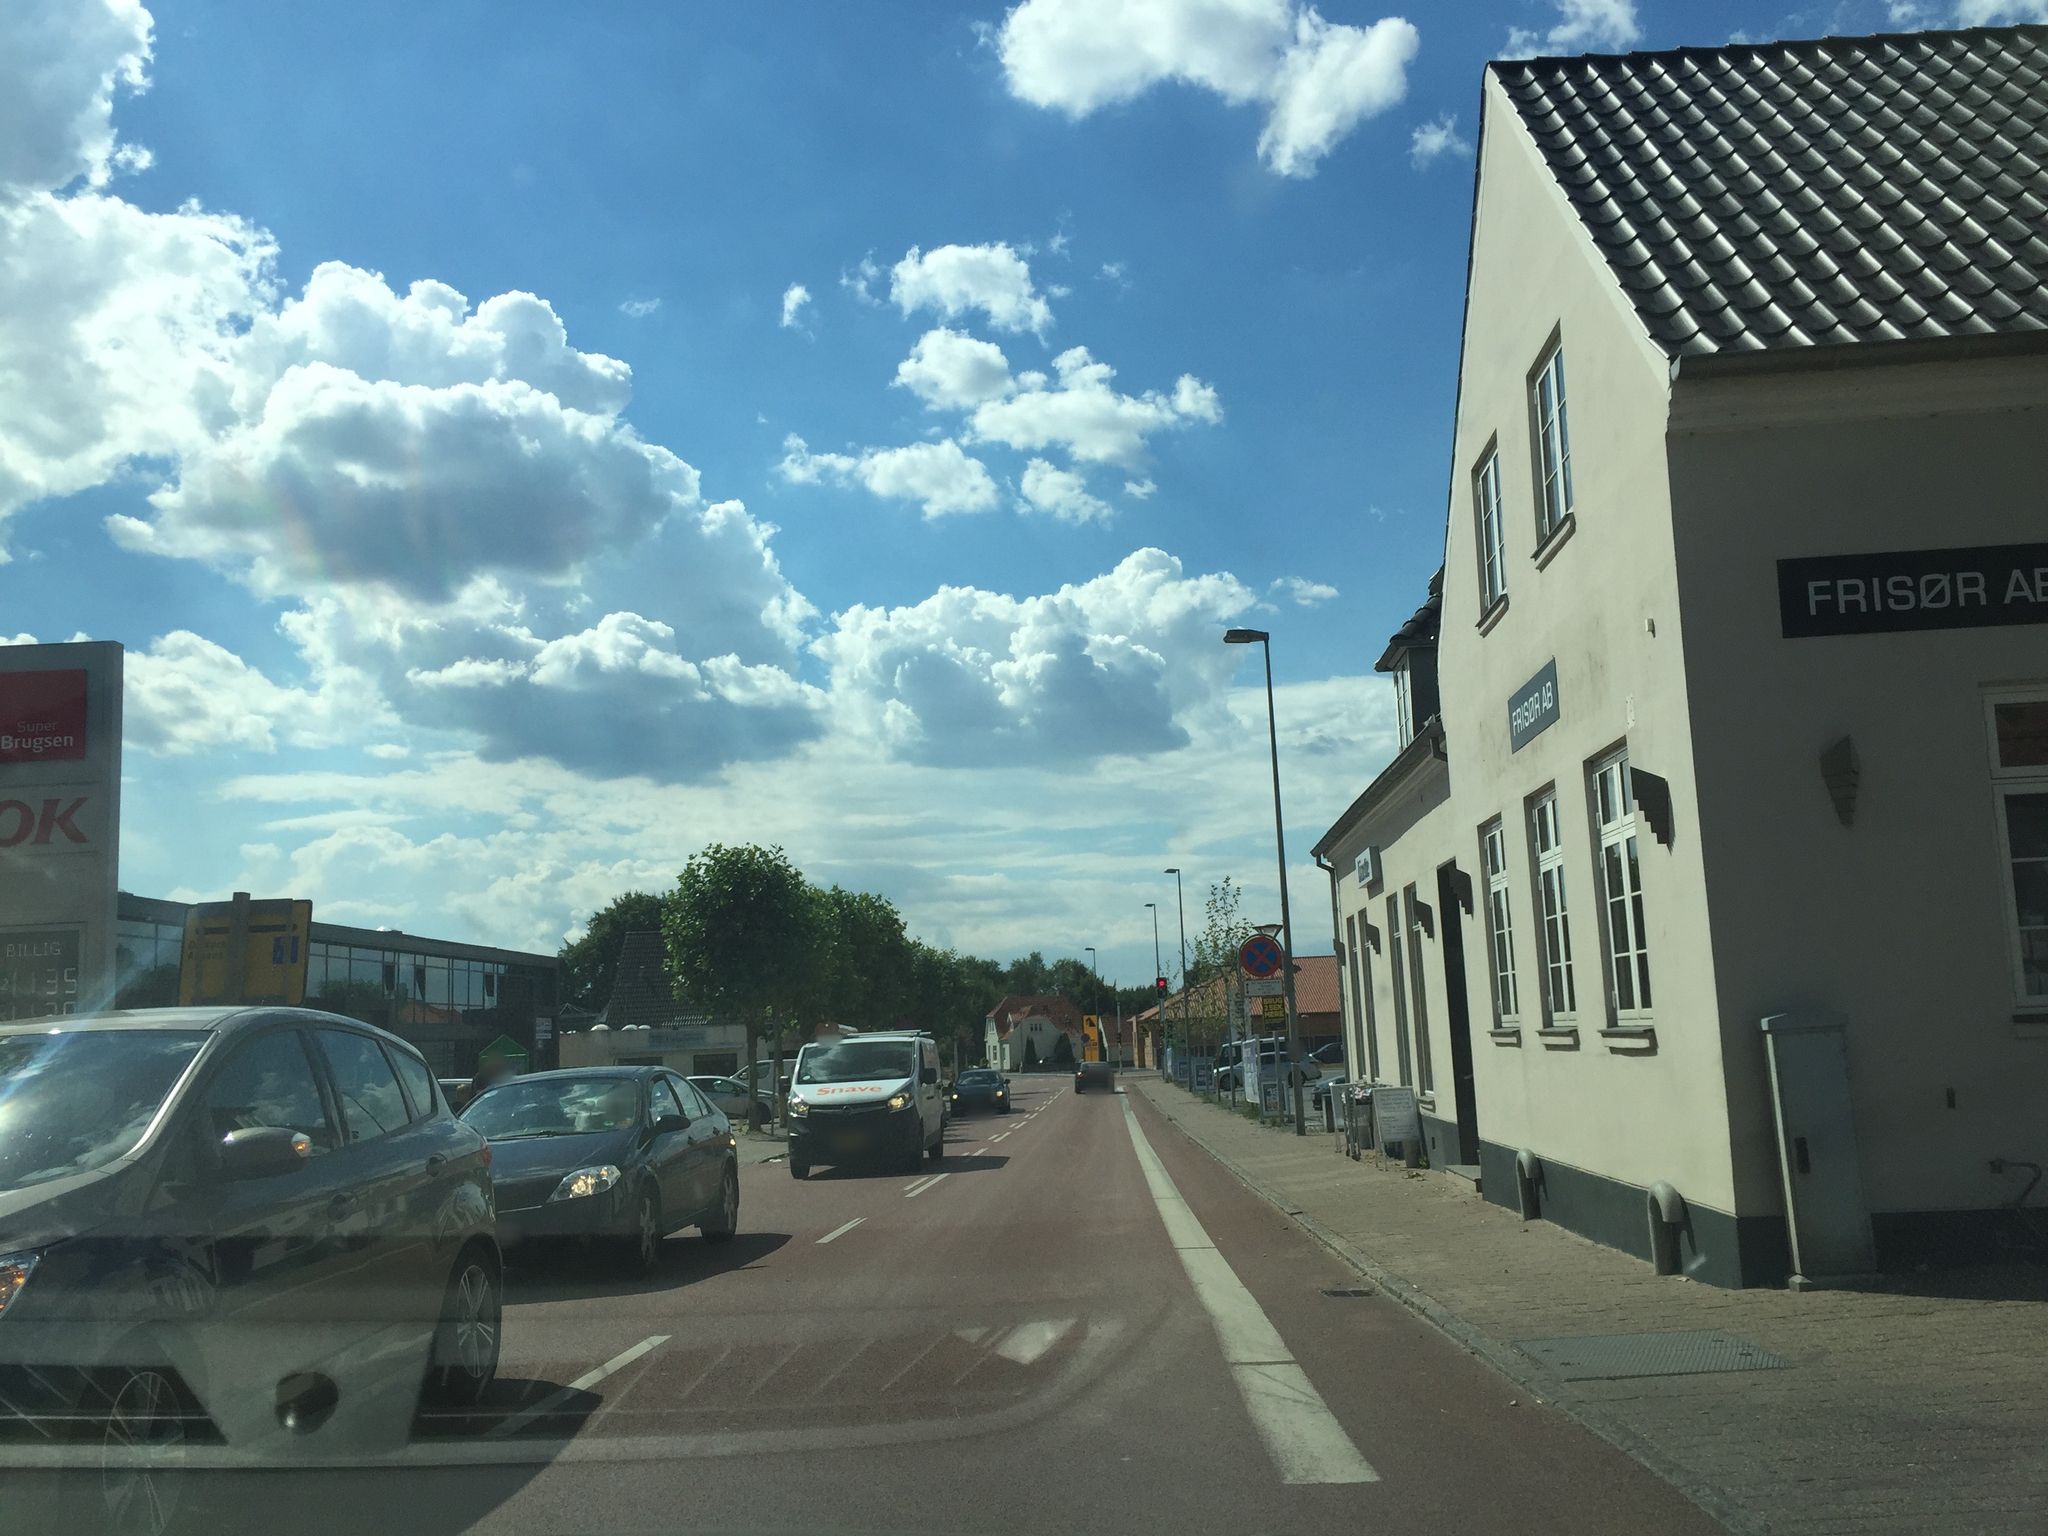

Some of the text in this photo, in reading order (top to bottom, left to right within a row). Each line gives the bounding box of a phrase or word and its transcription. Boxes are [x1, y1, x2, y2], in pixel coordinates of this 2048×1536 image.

[1807, 572, 1987, 615] FRISØR
[1512, 680, 1554, 737] FRISØR AB
[16, 720, 58, 735] Super
[0, 734, 74, 753] Brugsen
[0, 797, 89, 848] OK
[7, 942, 62, 958] BILLIG
[816, 1086, 882, 1096] Snave
